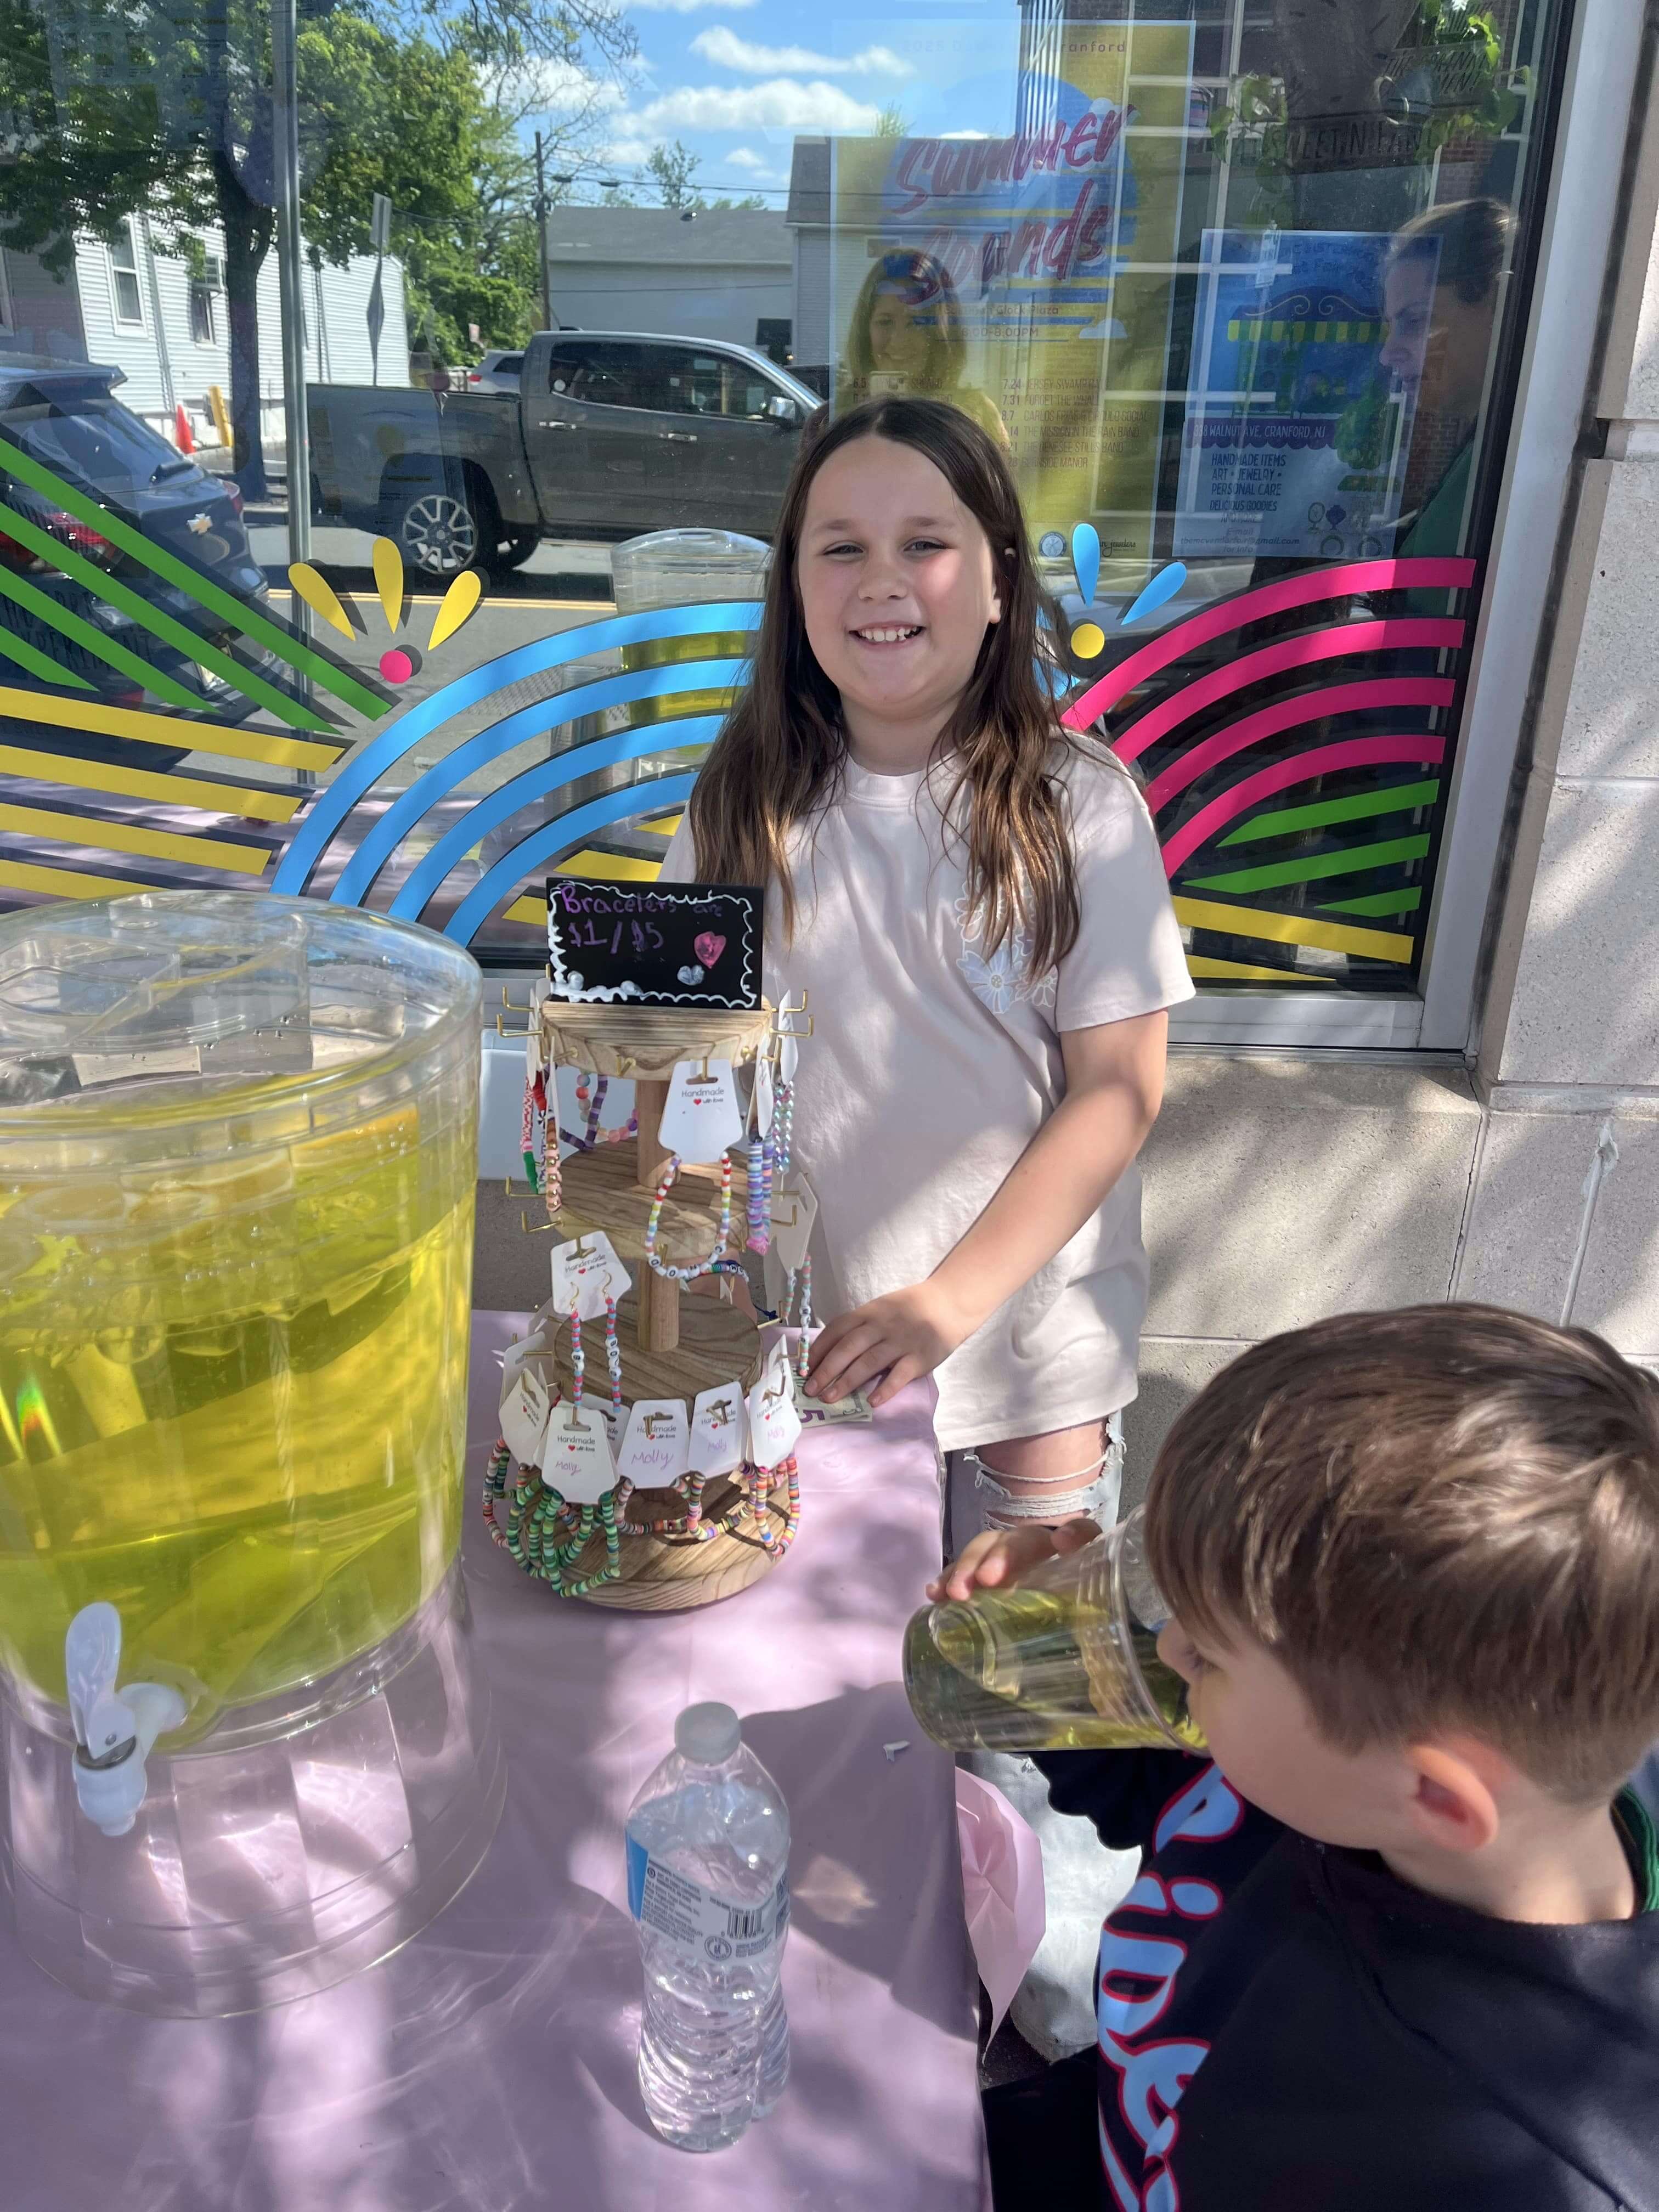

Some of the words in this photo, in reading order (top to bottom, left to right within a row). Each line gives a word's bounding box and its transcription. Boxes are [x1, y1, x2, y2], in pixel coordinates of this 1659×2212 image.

[1057, 40, 1125, 53] ranford
[1002, 394, 1020, 405] 7.31
[1057, 394, 1071, 406] THE
[1024, 410, 1054, 421] CARLOS
[1260, 454, 1286, 466] ITEMS
[1211, 468, 1228, 481] ART
[1257, 483, 1282, 496] CARE
[1246, 500, 1277, 511] GOODIES
[681, 1087, 724, 1097] Handmade
[565, 1254, 606, 1272] Handmade
[637, 1424, 676, 1433] Hadmade
[557, 1435, 596, 1444] Handmade
[631, 1449, 674, 1470] Molly
[555, 1461, 582, 1476] Molly
